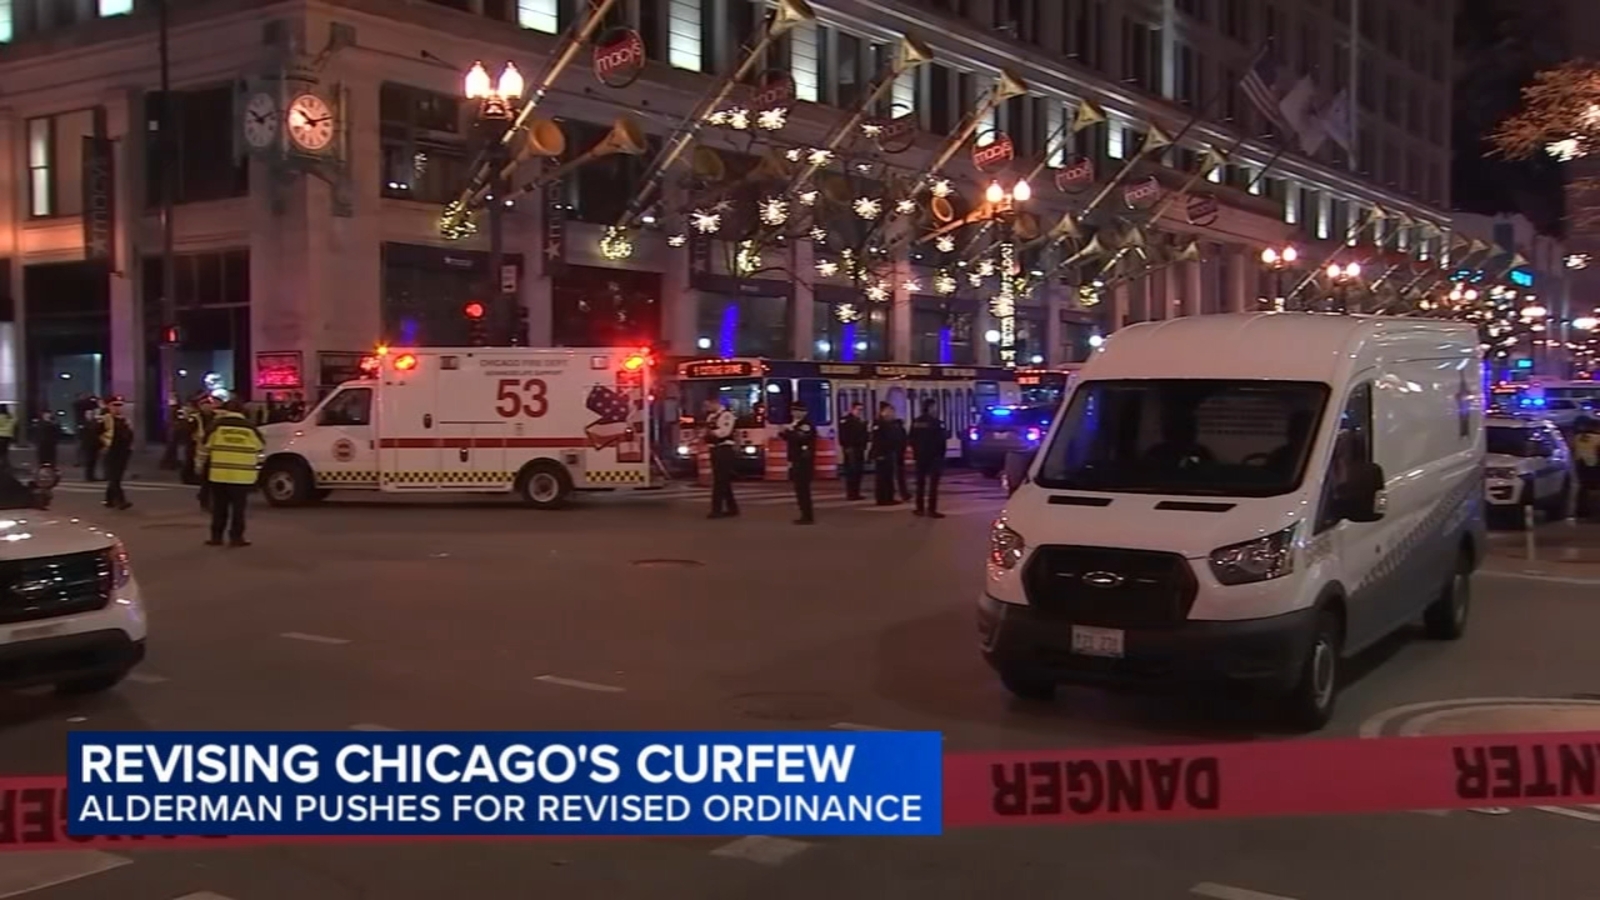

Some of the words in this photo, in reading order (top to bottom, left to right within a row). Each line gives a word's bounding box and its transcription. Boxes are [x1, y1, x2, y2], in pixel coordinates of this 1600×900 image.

[596, 38, 641, 72] macy's
[495, 379, 548, 418] 53
[991, 756, 1220, 816] DANGER
[1454, 744, 1600, 801] NTER
